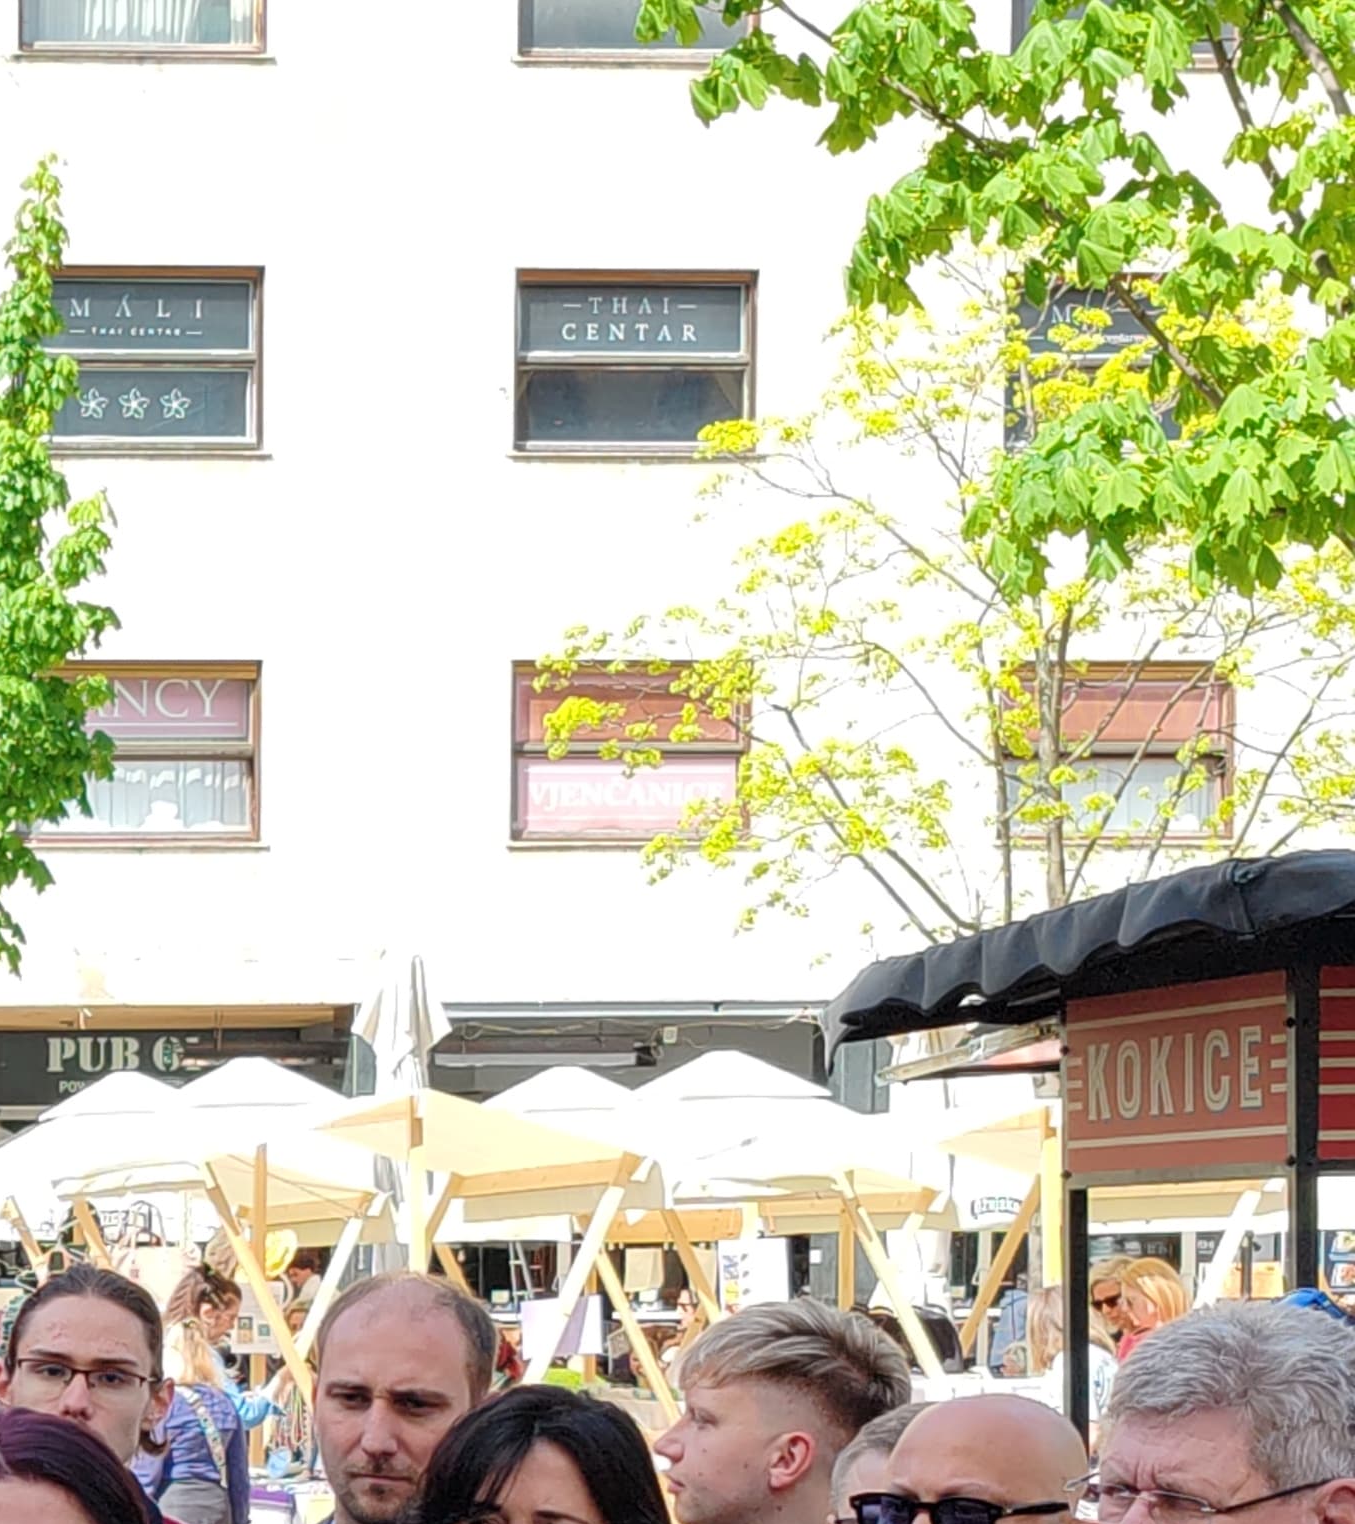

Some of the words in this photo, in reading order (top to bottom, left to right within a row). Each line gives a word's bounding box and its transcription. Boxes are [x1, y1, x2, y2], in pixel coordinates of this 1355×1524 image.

[70, 294, 203, 318] MÁLI
[588, 297, 670, 314] THAI
[561, 323, 697, 341] CENTAR
[46, 1036, 140, 1072] PUB
[1087, 1024, 1263, 1121] KOKICE
